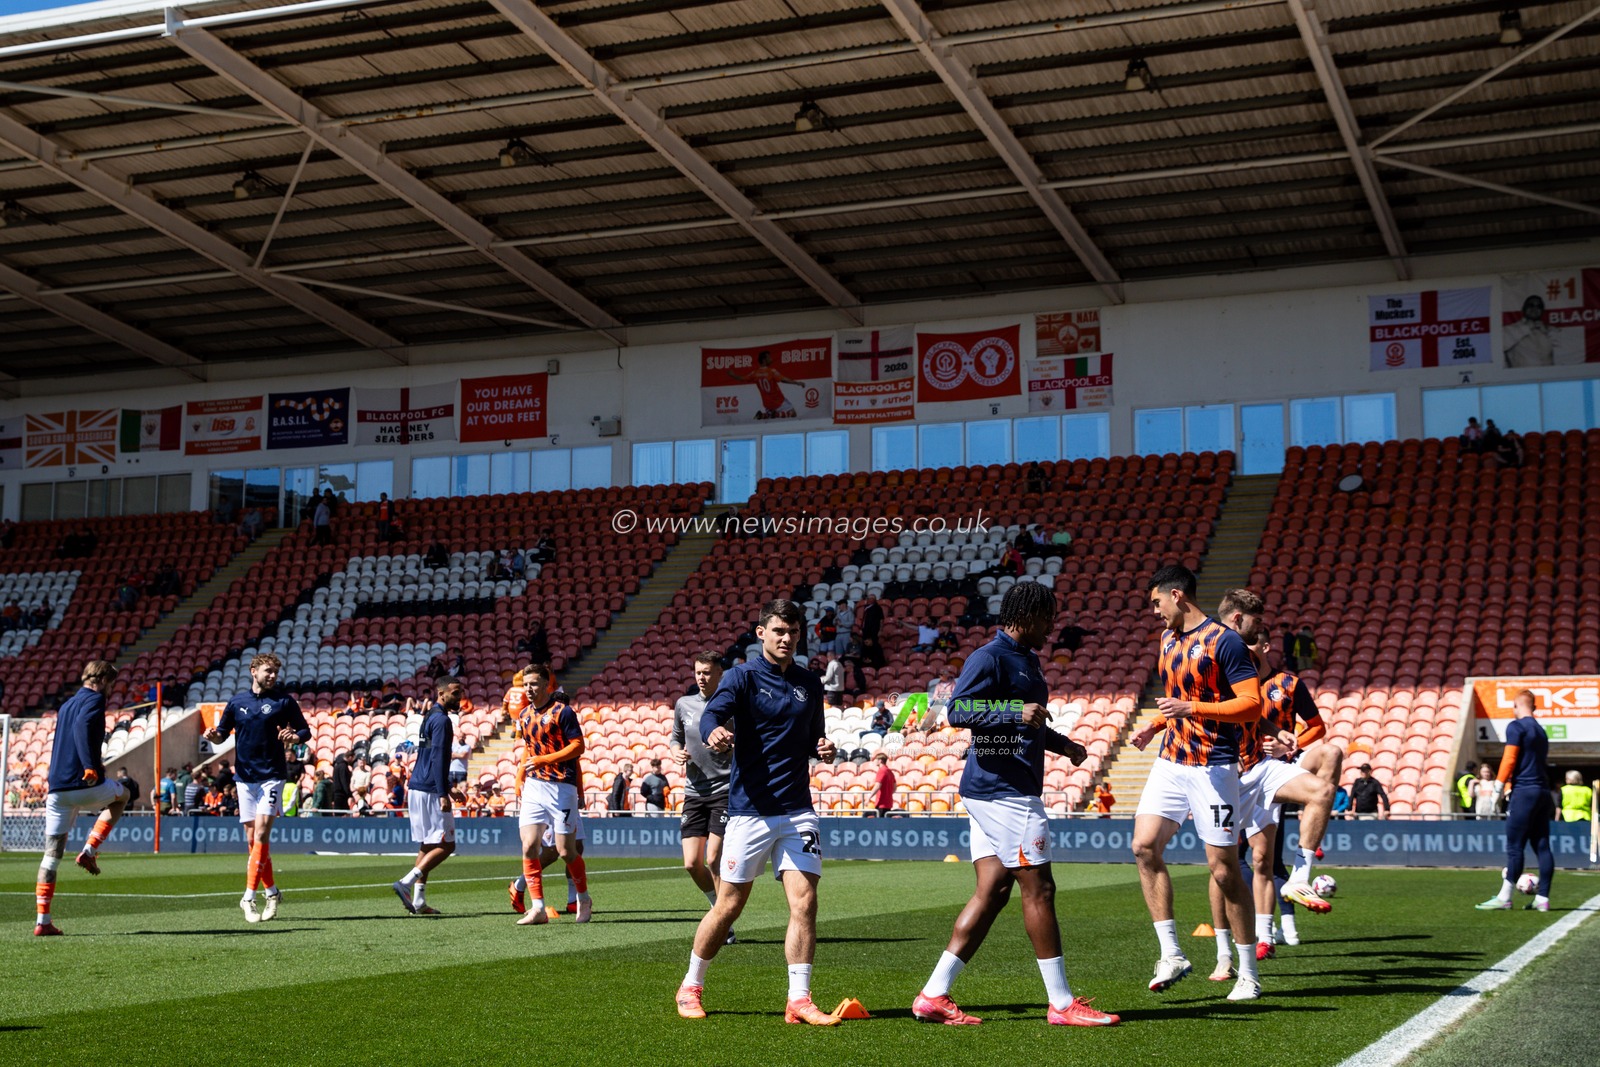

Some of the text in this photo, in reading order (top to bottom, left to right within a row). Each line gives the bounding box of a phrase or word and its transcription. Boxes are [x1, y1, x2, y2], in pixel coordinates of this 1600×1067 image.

[1546, 277, 1576, 301] #1
[1386, 299, 1402, 308] The
[1076, 311, 1098, 323] NATA
[1375, 308, 1415, 320] Muckers
[1375, 321, 1484, 339] BLACKPOOL F.C.
[926, 342, 965, 360] BLACKPOOL
[1452, 348, 1476, 360] 2004
[706, 355, 752, 370] SUPER
[781, 348, 827, 364] BRETT
[884, 362, 908, 372] 2020
[836, 381, 912, 394] BLACKPOOL FC
[1031, 376, 1110, 390] BLACKPOOL FC
[475, 385, 532, 398] YOU HAVE
[466, 398, 541, 412] OUR DREAMS
[716, 396, 739, 408] FY6
[882, 396, 911, 404] #UTMP
[366, 408, 445, 420] BLACKPOOL FC
[466, 411, 541, 426] AT YOUR FEET
[848, 412, 876, 420] STANLEY
[876, 410, 912, 418] MATTHEWS
[212, 418, 236, 432] bsa
[273, 416, 309, 427] B.A.S.I.L.
[28, 431, 114, 445] SOUTH SHORE SEASIDERS
[375, 432, 434, 443] SEASIDERS
[102, 466, 108, 474] D
[1496, 688, 1600, 708] LNKS
[1478, 726, 1488, 740] 1
[201, 741, 208, 752] 2
[269, 791, 278, 804] 5
[562, 809, 571, 823] 7
[1210, 804, 1234, 828] 12
[68, 828, 502, 844] BLKPOO FOOTBAL CLUB COMMUNI RUST
[592, 830, 683, 846] BUILDIN
[830, 830, 950, 847] SPONSORS
[1286, 833, 1352, 852] CUB
[1363, 834, 1508, 854] COMMUNIT
